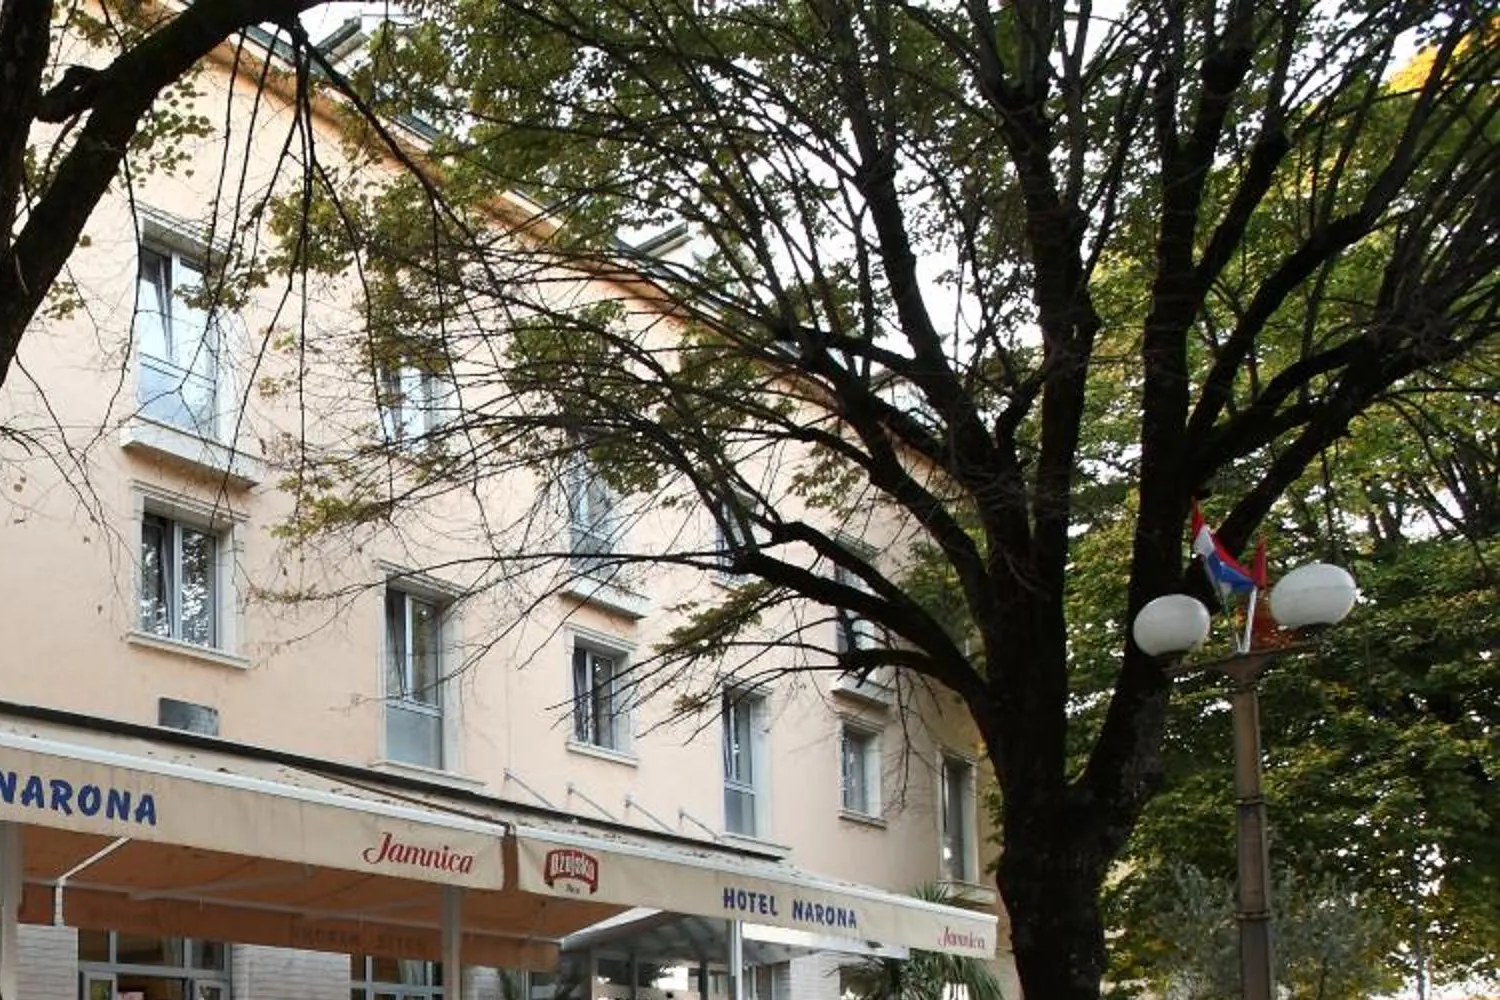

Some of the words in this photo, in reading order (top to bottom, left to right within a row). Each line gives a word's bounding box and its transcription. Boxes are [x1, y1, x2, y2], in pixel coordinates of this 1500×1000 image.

[363, 831, 474, 875] Jamnica
[723, 887, 779, 917] HOTEL
[792, 899, 858, 929] NARONA
